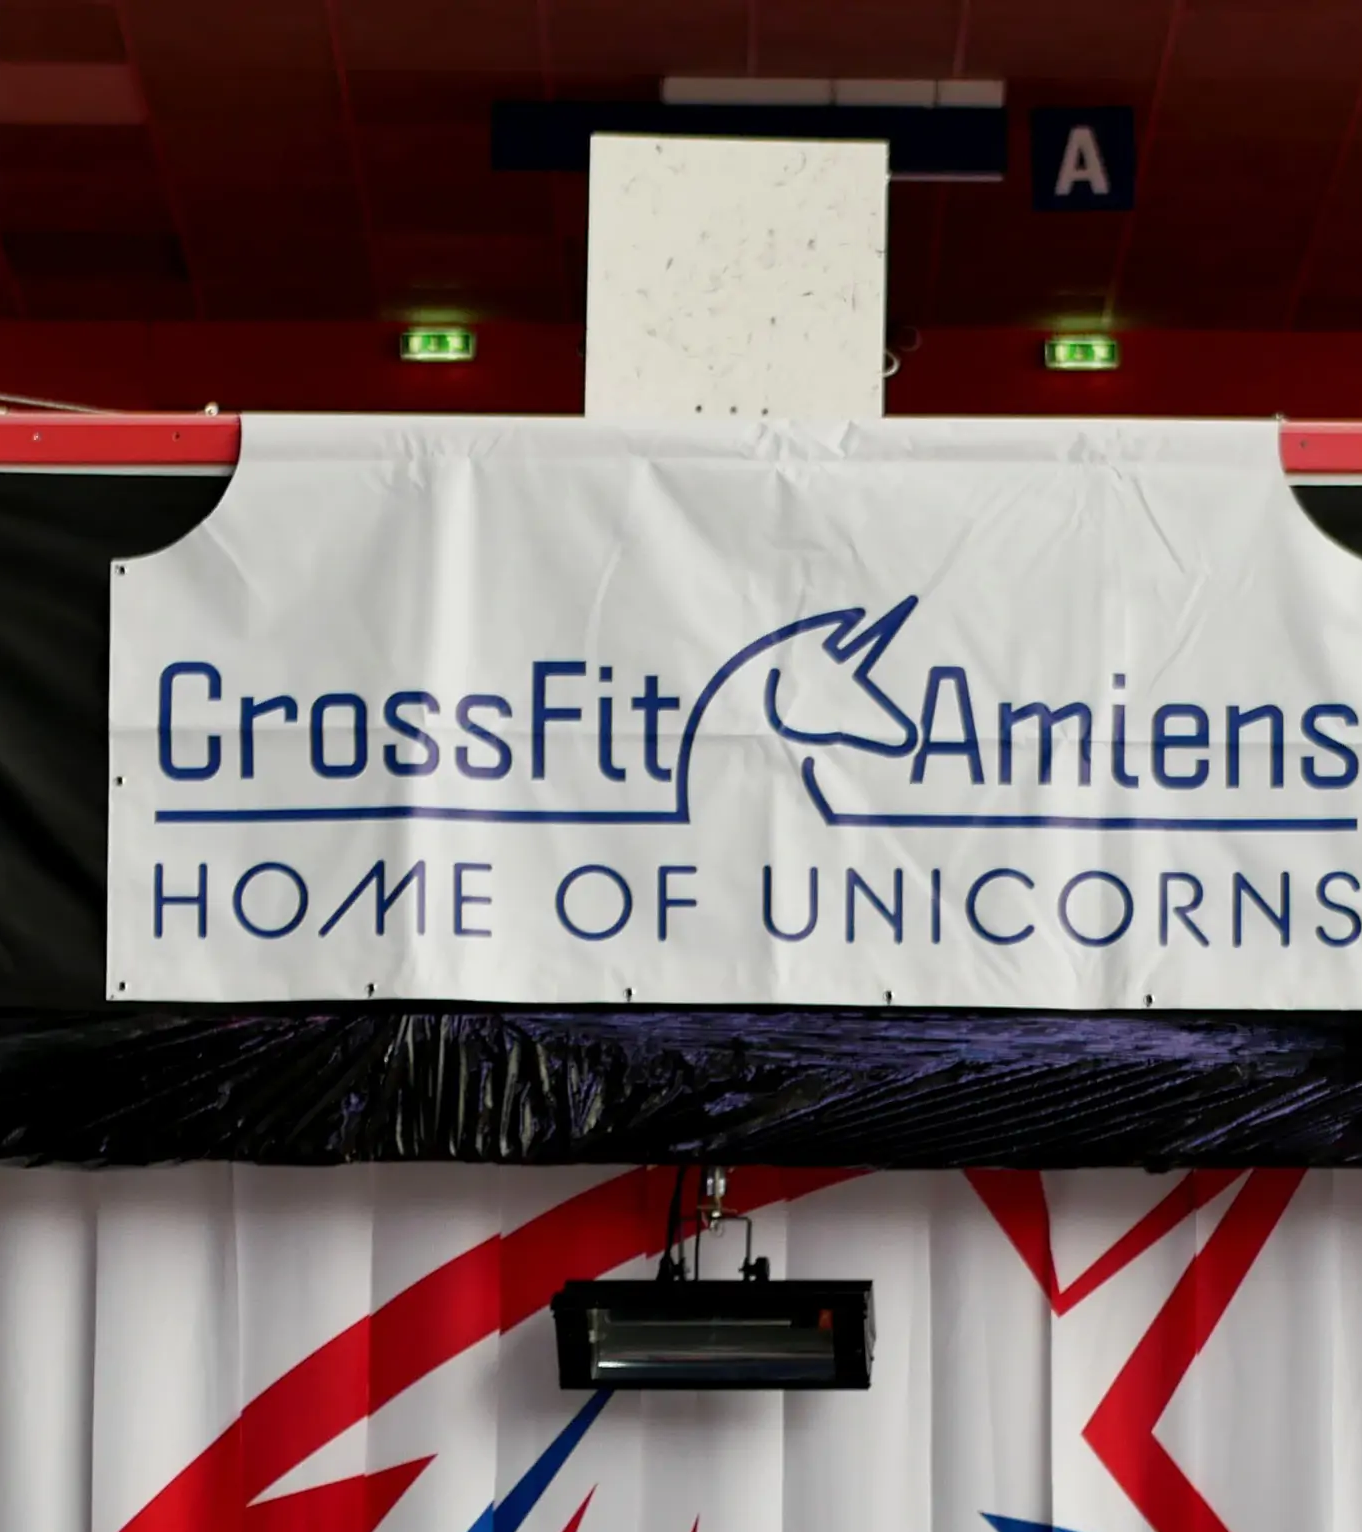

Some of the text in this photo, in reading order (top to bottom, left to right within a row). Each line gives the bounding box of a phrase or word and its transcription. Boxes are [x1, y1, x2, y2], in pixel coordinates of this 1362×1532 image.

[1054, 125, 1110, 196] A
[157, 659, 1360, 790] CrossFit Amiens
[153, 859, 1362, 948] HOME OF UNICORNS
